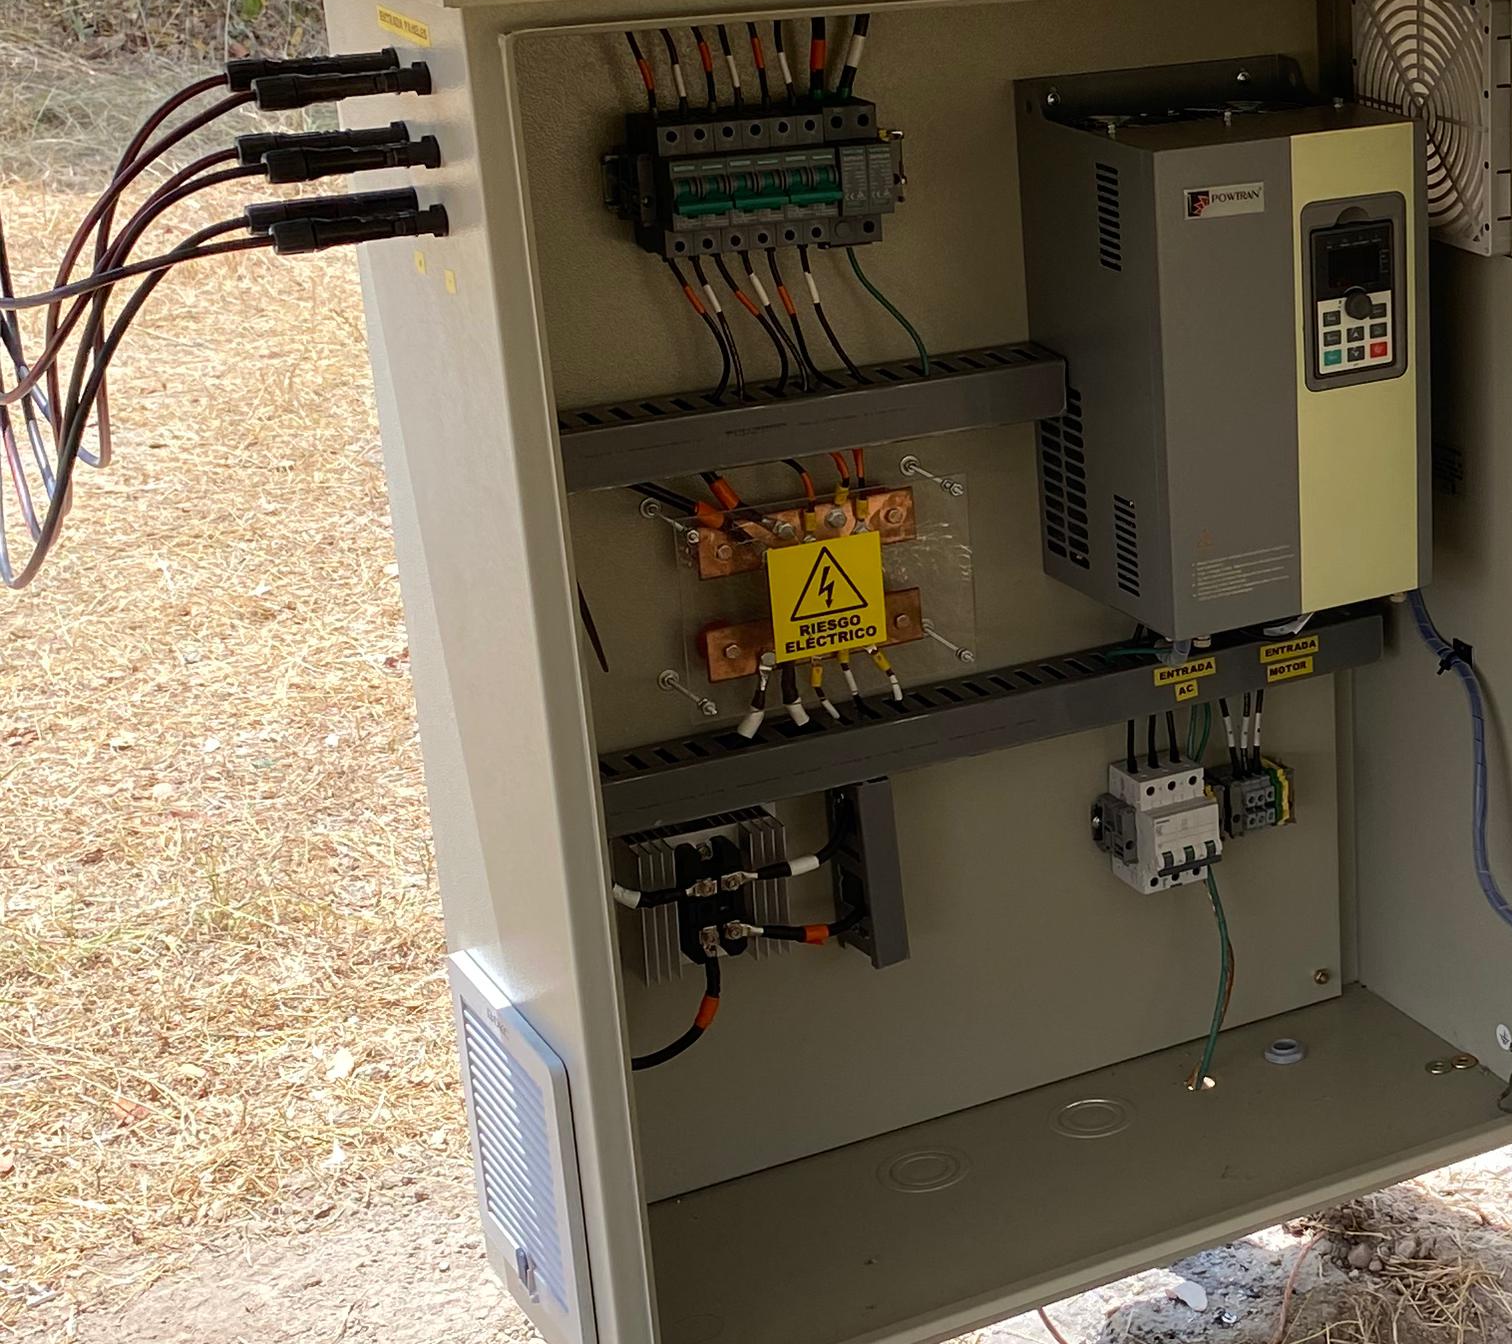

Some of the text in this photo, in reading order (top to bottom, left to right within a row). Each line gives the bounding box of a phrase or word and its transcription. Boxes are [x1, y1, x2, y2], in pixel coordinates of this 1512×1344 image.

[1211, 190, 1259, 203] POWTRAN
[799, 614, 861, 637] RIESGO
[785, 625, 877, 654] ELÉCTRICO
[1265, 639, 1317, 658] ENTRADA
[1159, 661, 1213, 681] ENTRADA
[1269, 661, 1307, 676] MOTOR
[1178, 684, 1194, 696] AC
